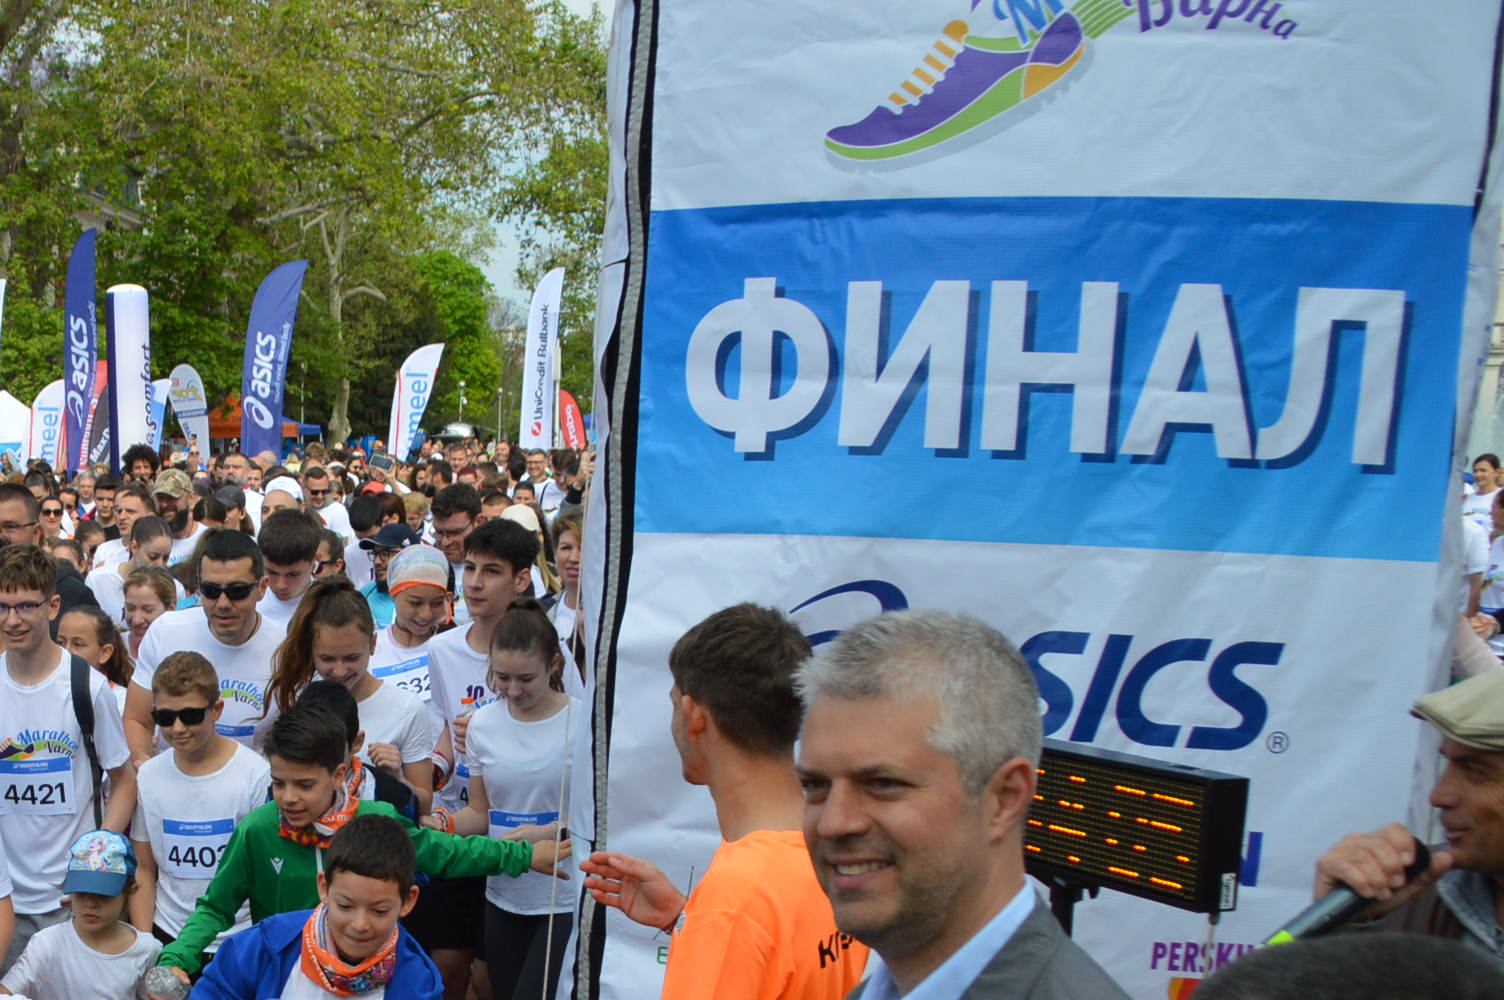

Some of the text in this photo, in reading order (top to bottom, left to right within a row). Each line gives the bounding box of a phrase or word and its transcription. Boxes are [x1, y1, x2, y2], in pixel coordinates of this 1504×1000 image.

[70, 314, 91, 392] asics
[251, 331, 276, 399] asics
[534, 304, 549, 421] UniCredit Bulbank
[684, 275, 1409, 468] ФИНАЛ
[4, 782, 67, 806] 4421
